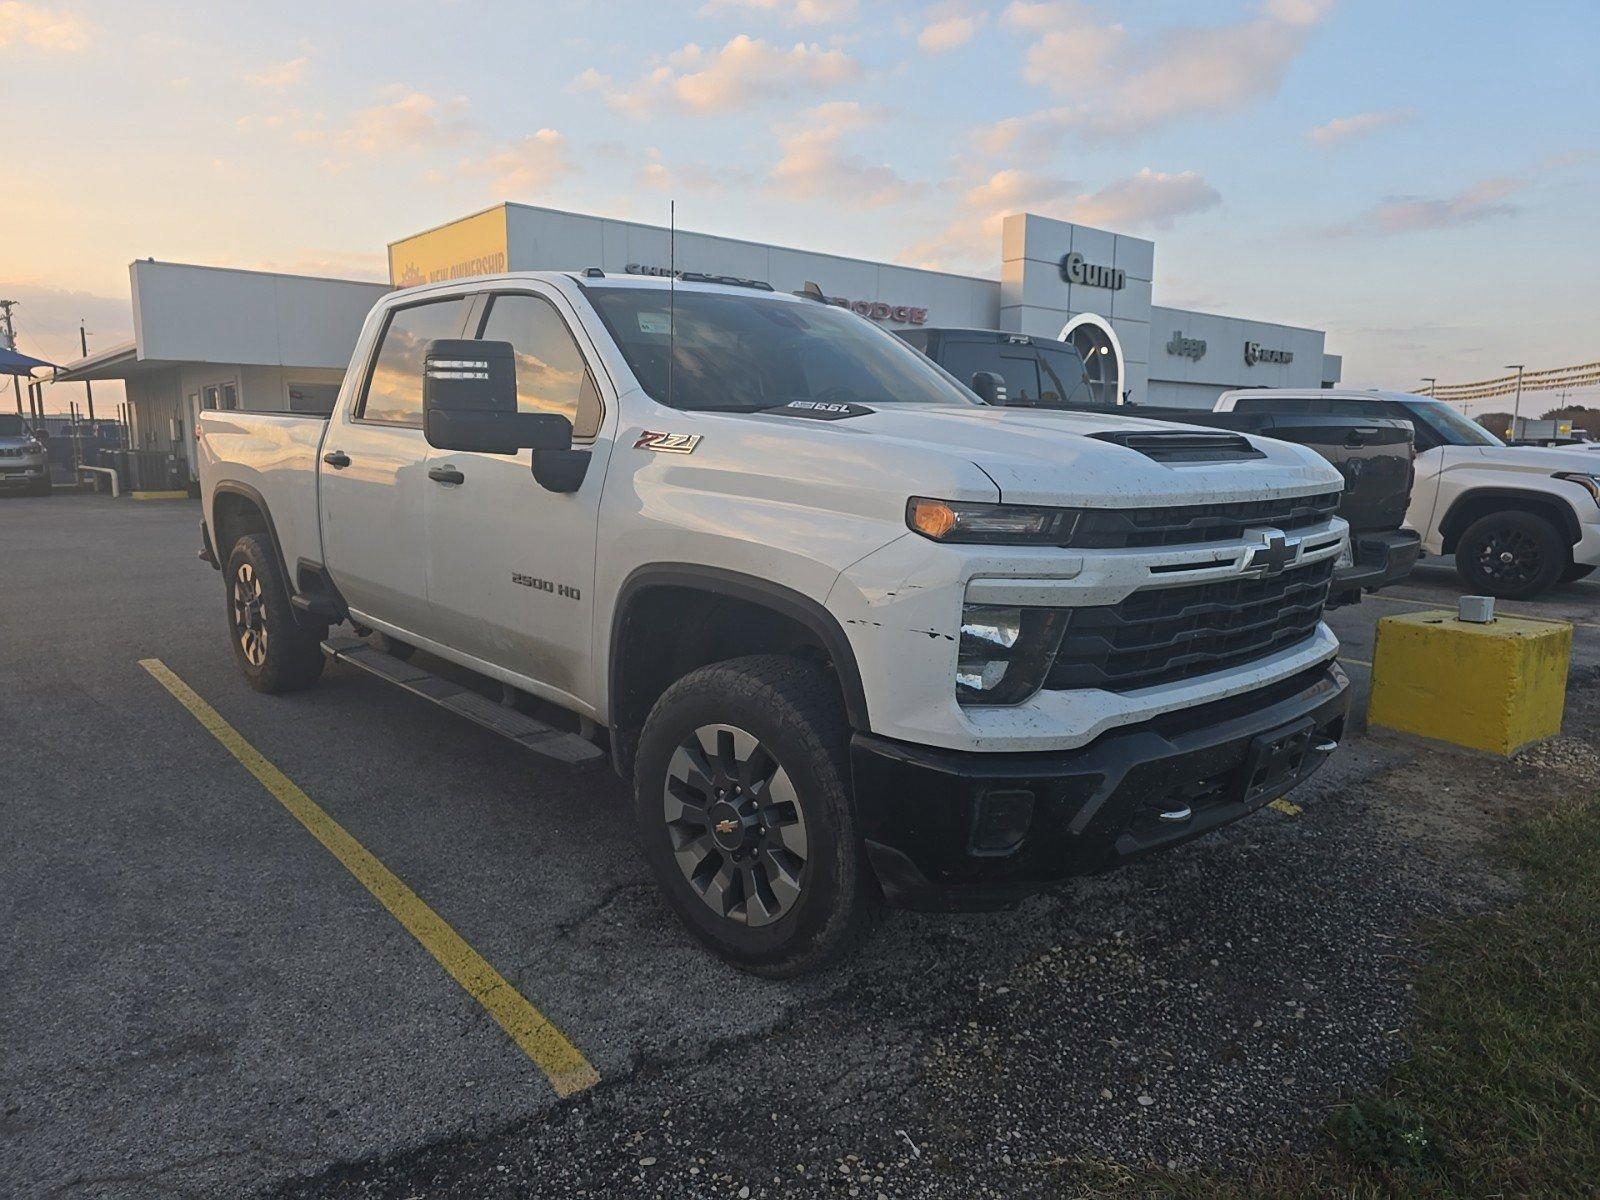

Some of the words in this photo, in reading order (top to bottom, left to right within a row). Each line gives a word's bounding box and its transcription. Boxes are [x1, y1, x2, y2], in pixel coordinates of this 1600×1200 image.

[429, 266, 449, 284] NEW
[450, 251, 505, 280] OWNERSHIP
[1061, 251, 1126, 290] Gunn
[832, 297, 928, 325] DODGE
[1166, 330, 1207, 363] Jeep
[1259, 348, 1294, 364] RAM
[632, 430, 704, 454] Z71
[511, 571, 554, 593] 2500
[557, 584, 581, 601] HD
